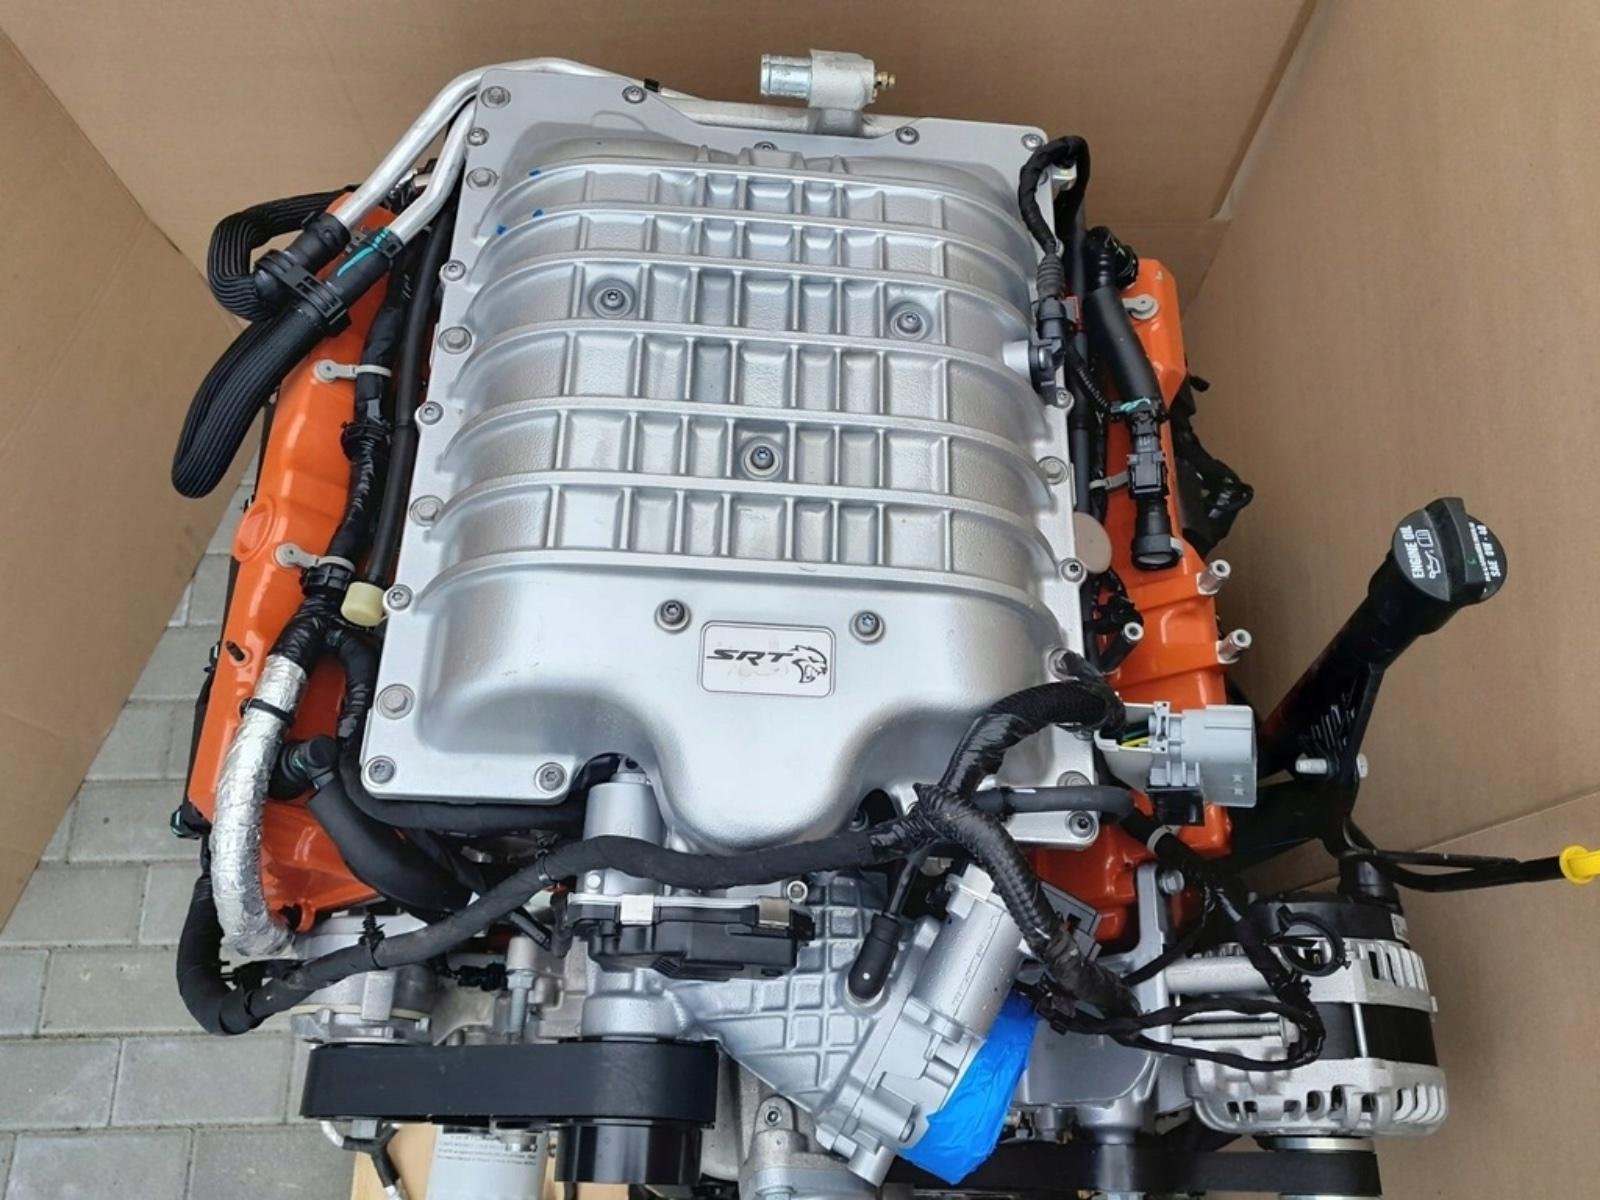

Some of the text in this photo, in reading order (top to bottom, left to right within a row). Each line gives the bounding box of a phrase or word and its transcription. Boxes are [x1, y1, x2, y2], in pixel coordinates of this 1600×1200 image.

[1400, 524, 1426, 579] ENGINE OIL
[1487, 559, 1502, 578] SAE
[706, 648, 794, 666] SRT
